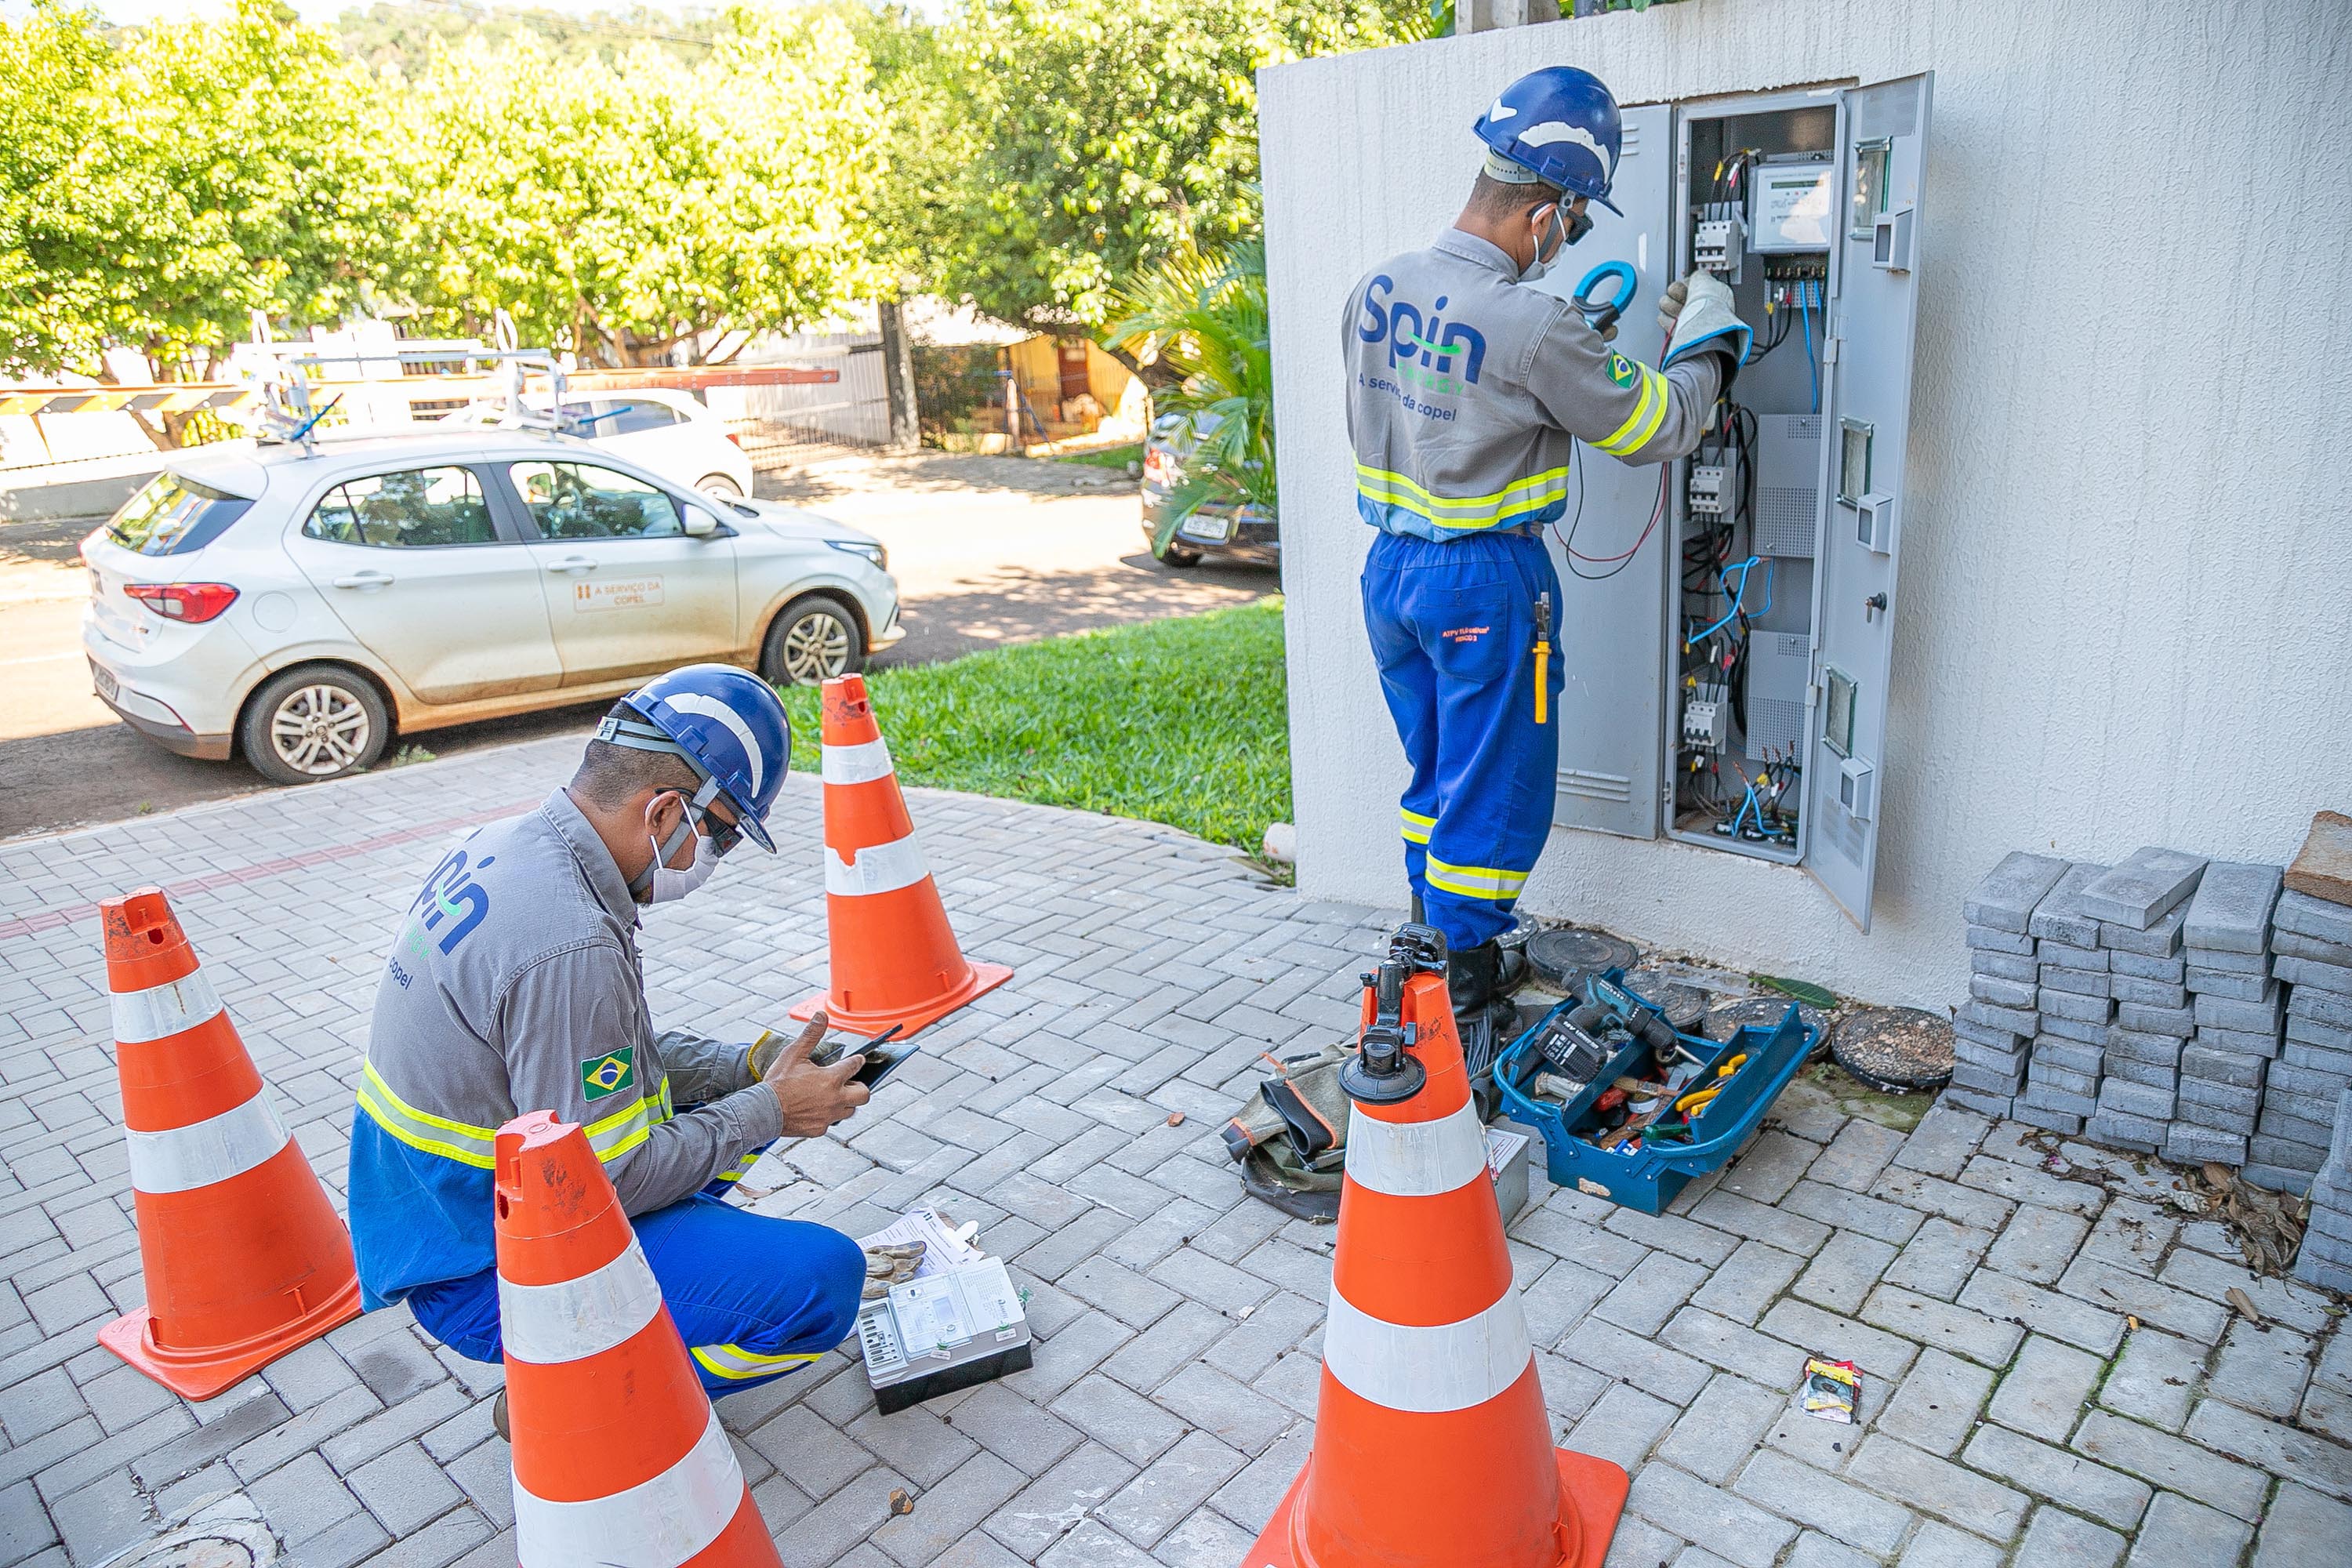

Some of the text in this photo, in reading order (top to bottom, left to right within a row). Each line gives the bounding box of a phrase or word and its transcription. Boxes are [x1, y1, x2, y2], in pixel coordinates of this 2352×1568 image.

[1359, 274, 1486, 384] Spin
[1403, 394, 1416, 409] da
[1417, 403, 1457, 421] copel
